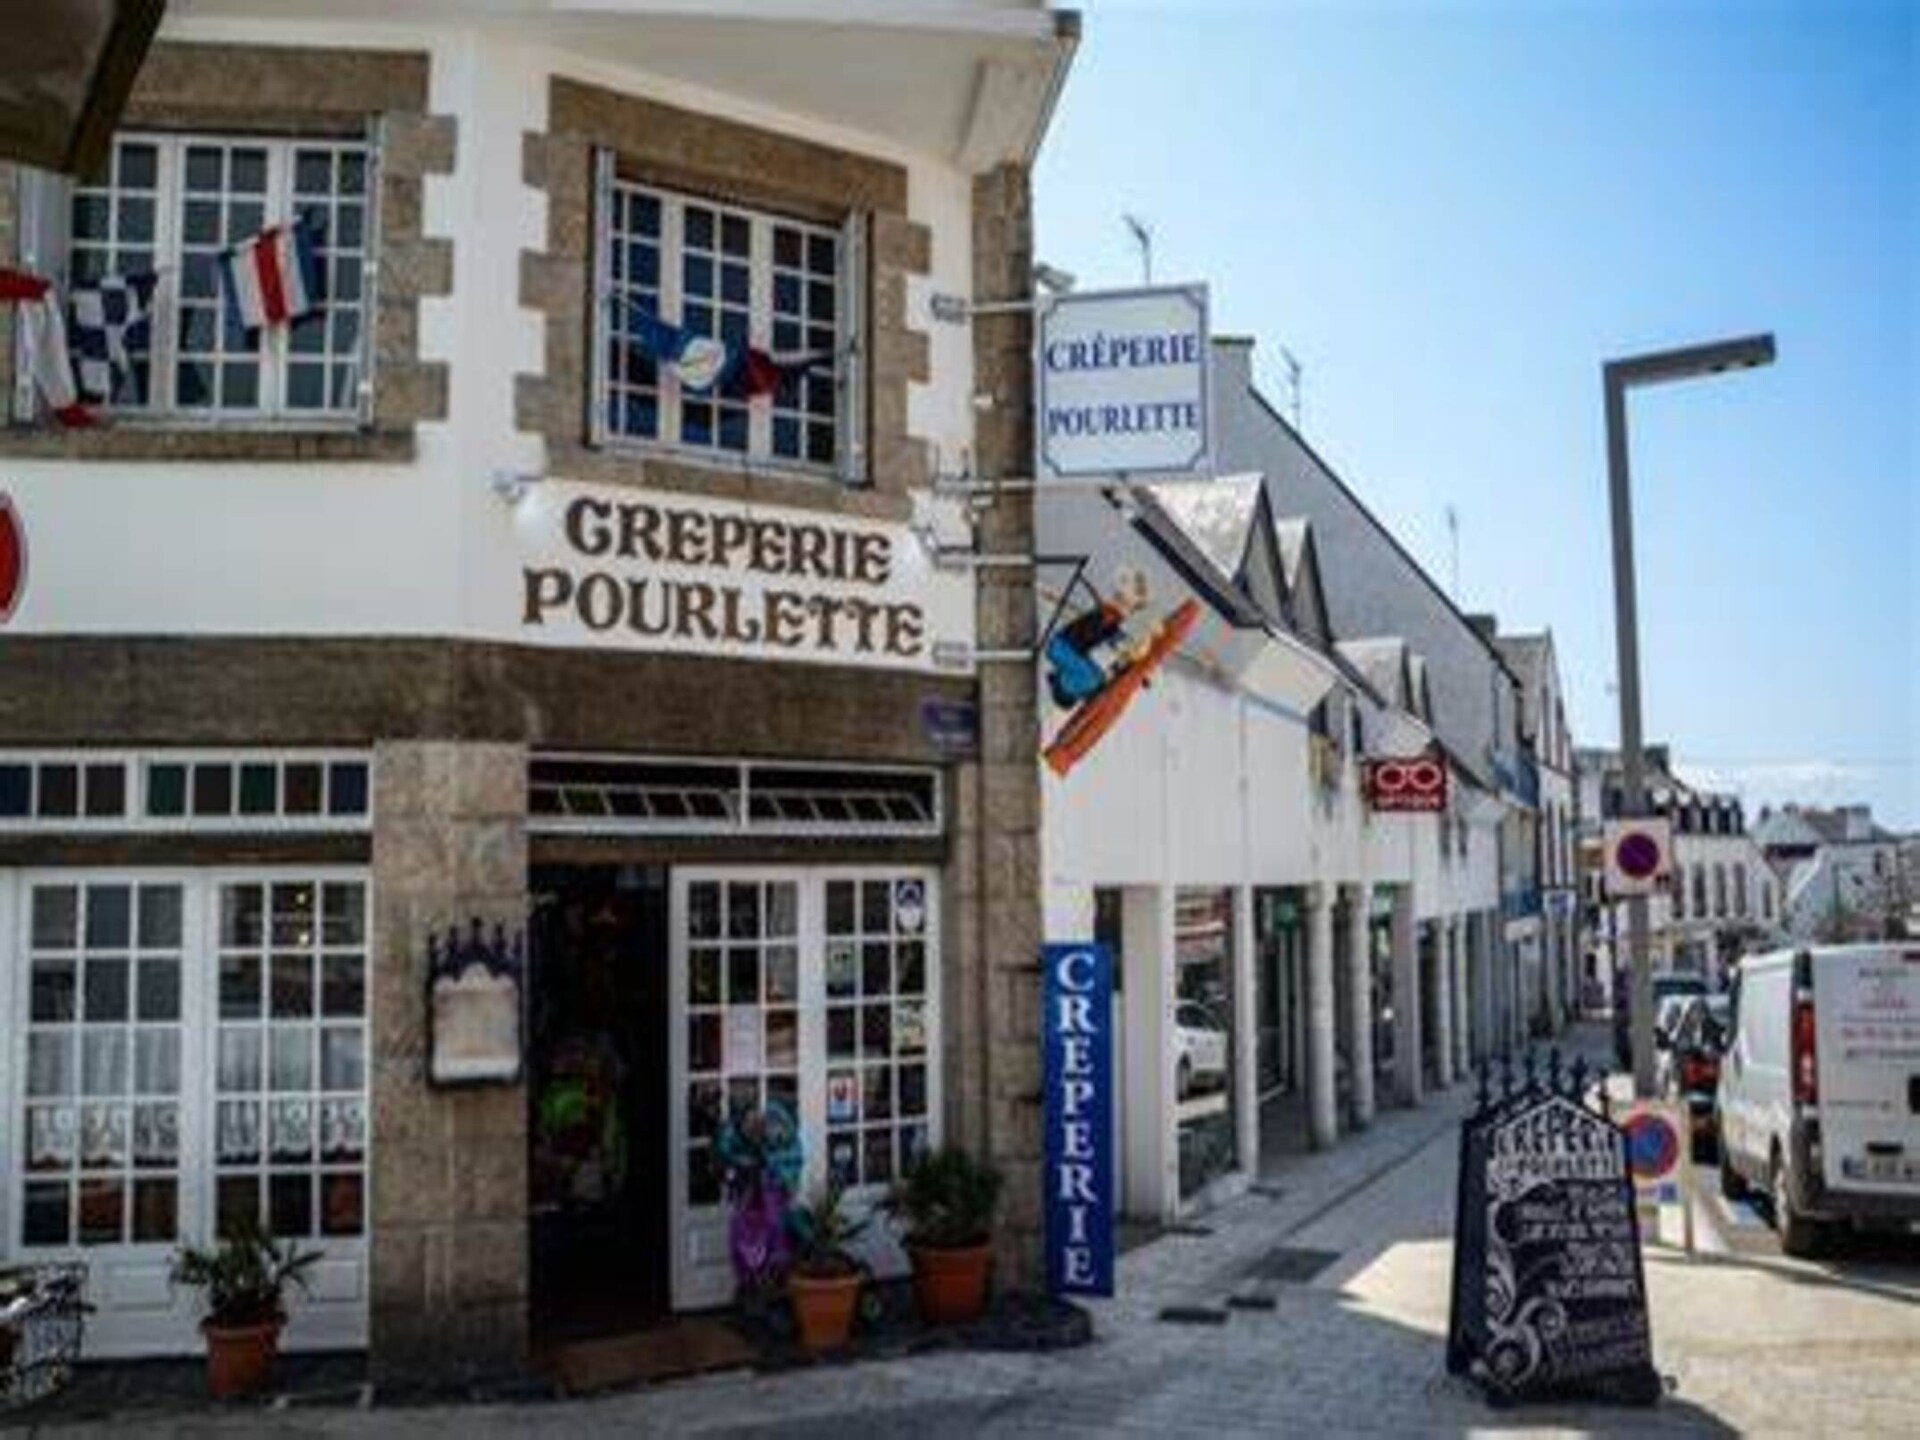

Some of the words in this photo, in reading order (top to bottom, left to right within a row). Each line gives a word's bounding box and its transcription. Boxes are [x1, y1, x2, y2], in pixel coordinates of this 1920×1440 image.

[1047, 403, 1197, 437] POURLETTE
[521, 567, 924, 657] POURLETTE
[1057, 952, 1097, 1286] CREPERIE
